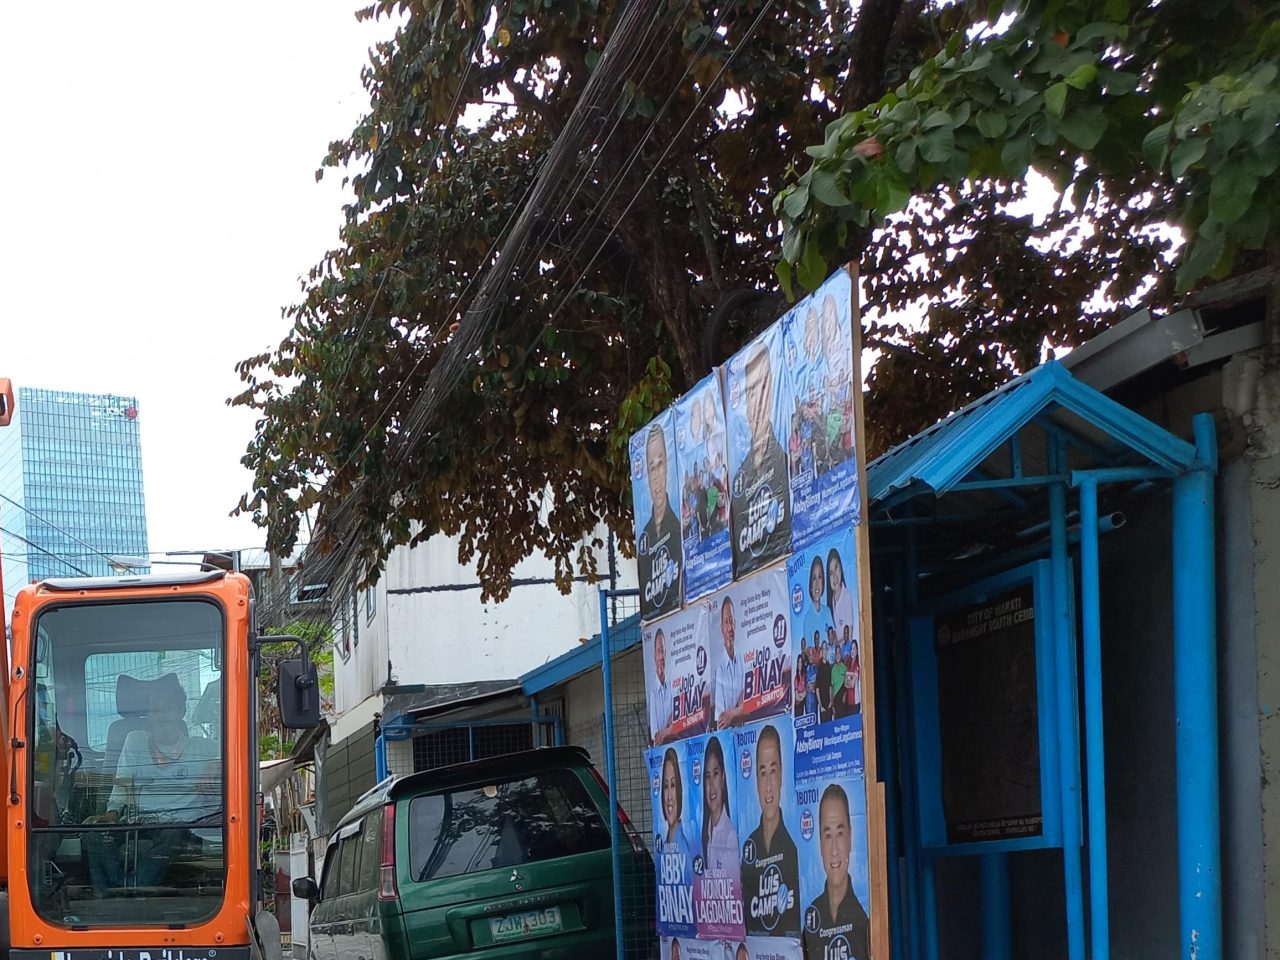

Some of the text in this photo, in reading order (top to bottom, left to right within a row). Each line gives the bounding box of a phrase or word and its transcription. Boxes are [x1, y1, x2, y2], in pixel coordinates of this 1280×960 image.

[1013, 607, 1035, 624] CEMB
[745, 843, 753, 860] #1
[660, 853, 686, 885] ABBY
[755, 853, 783, 869] Congressman
[700, 879, 734, 901] MONIQUE
[658, 885, 694, 924] BINAY
[695, 900, 743, 925] LAGDAMEO
[806, 911, 816, 929] #1
[820, 923, 853, 938] Congressman
